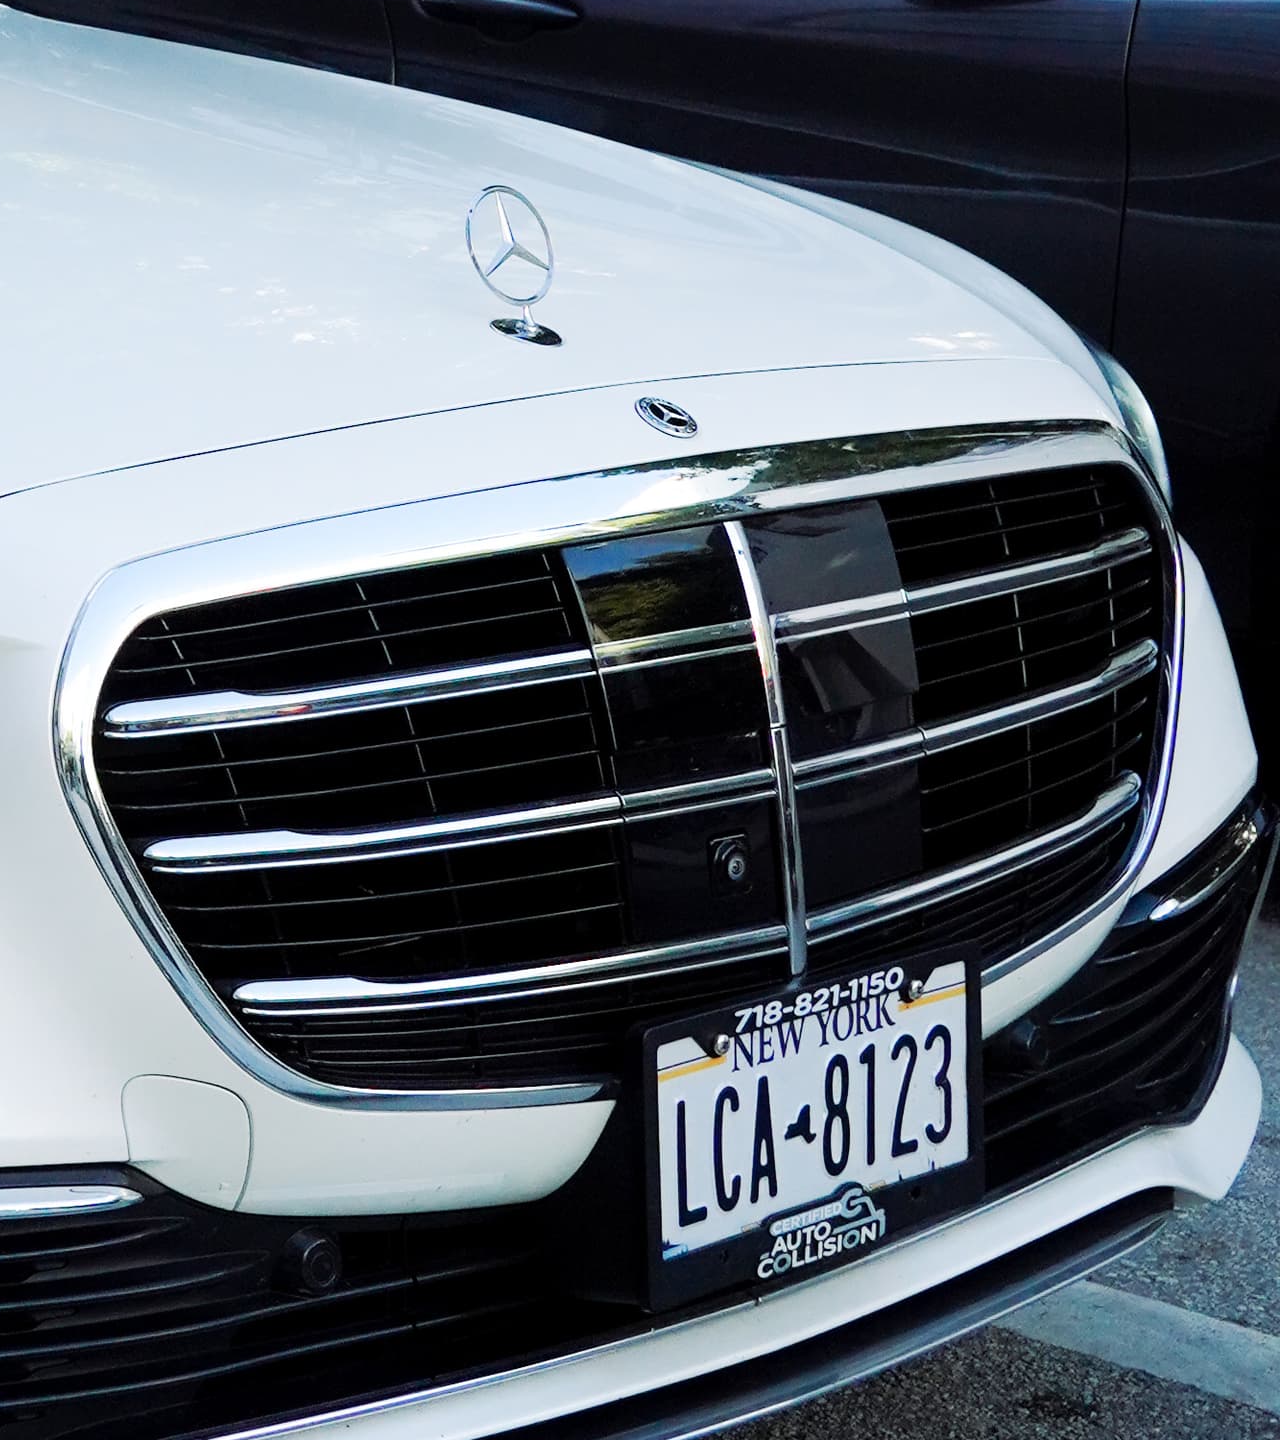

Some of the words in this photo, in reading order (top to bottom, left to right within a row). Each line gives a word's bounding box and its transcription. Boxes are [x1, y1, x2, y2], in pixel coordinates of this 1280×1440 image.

[734, 967, 904, 1033] 718-821-1150
[732, 1016, 806, 1073] NEW
[818, 993, 896, 1048] YORK
[770, 1201, 842, 1236] CERTIFIED
[771, 1221, 832, 1257] AUTO
[757, 1223, 877, 1280] COLLISION
